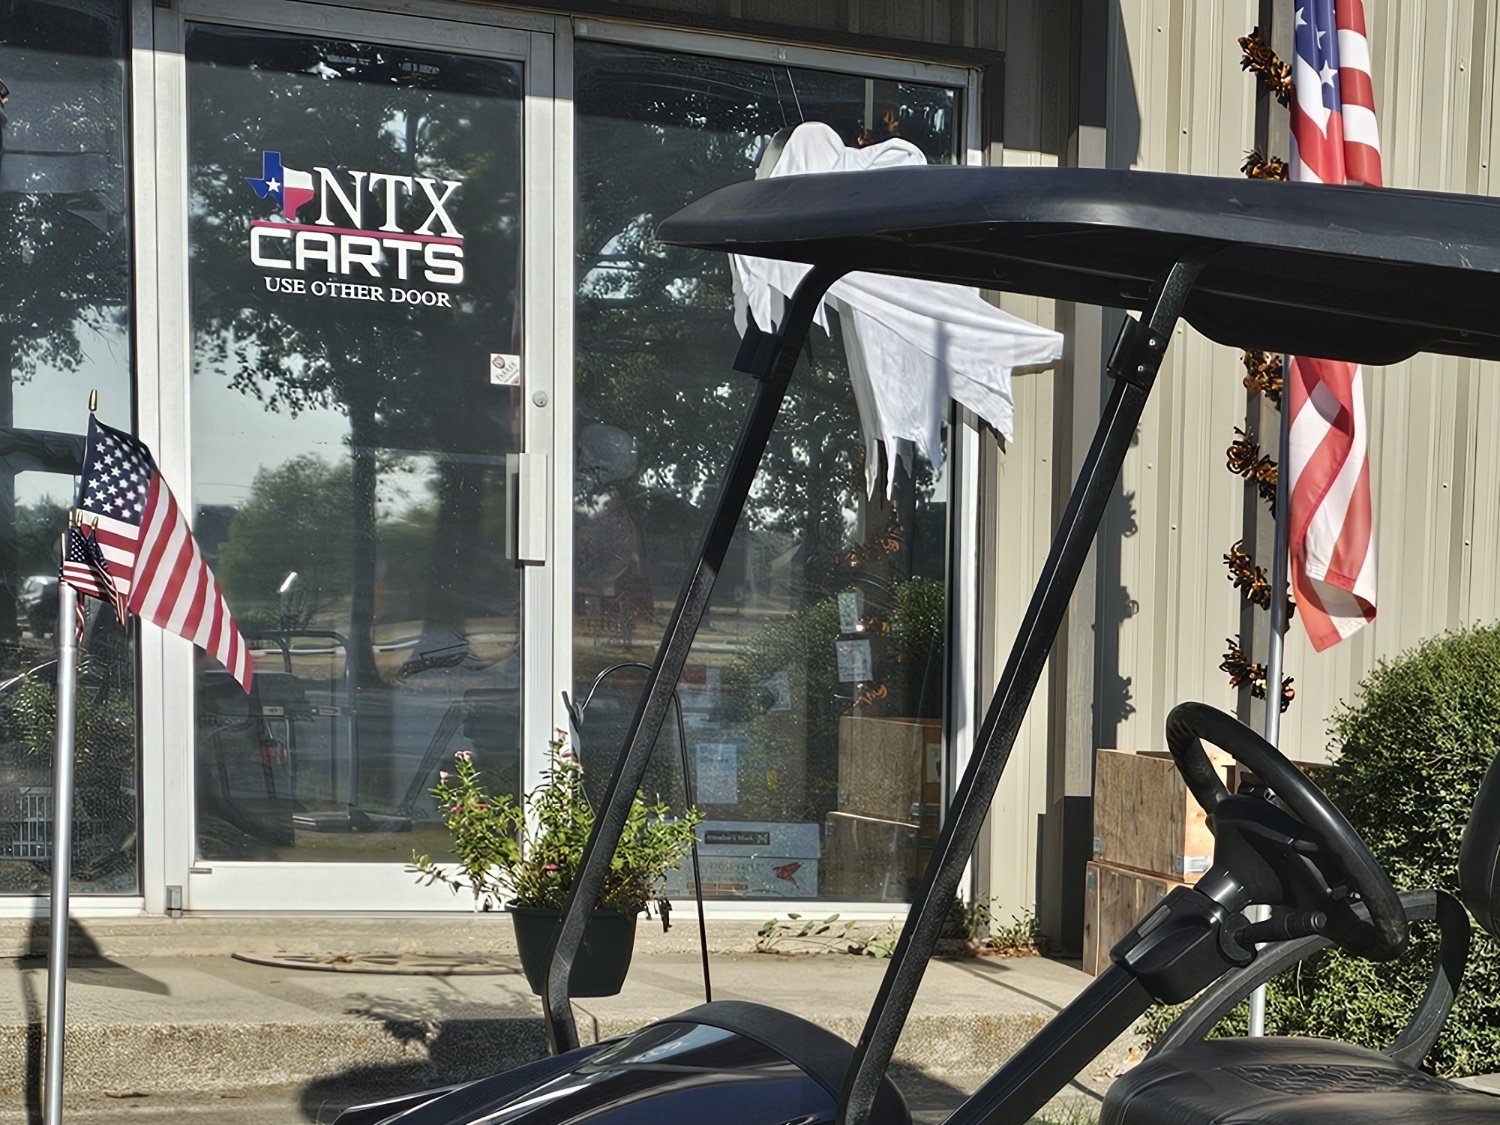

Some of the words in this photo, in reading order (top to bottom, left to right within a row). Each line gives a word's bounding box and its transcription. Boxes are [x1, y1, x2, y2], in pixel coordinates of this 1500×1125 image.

[313, 166, 464, 239] NTX
[250, 226, 464, 284] CARTS
[263, 276, 307, 295] USE
[310, 281, 386, 302] OTHER
[389, 287, 452, 308] DOOR
